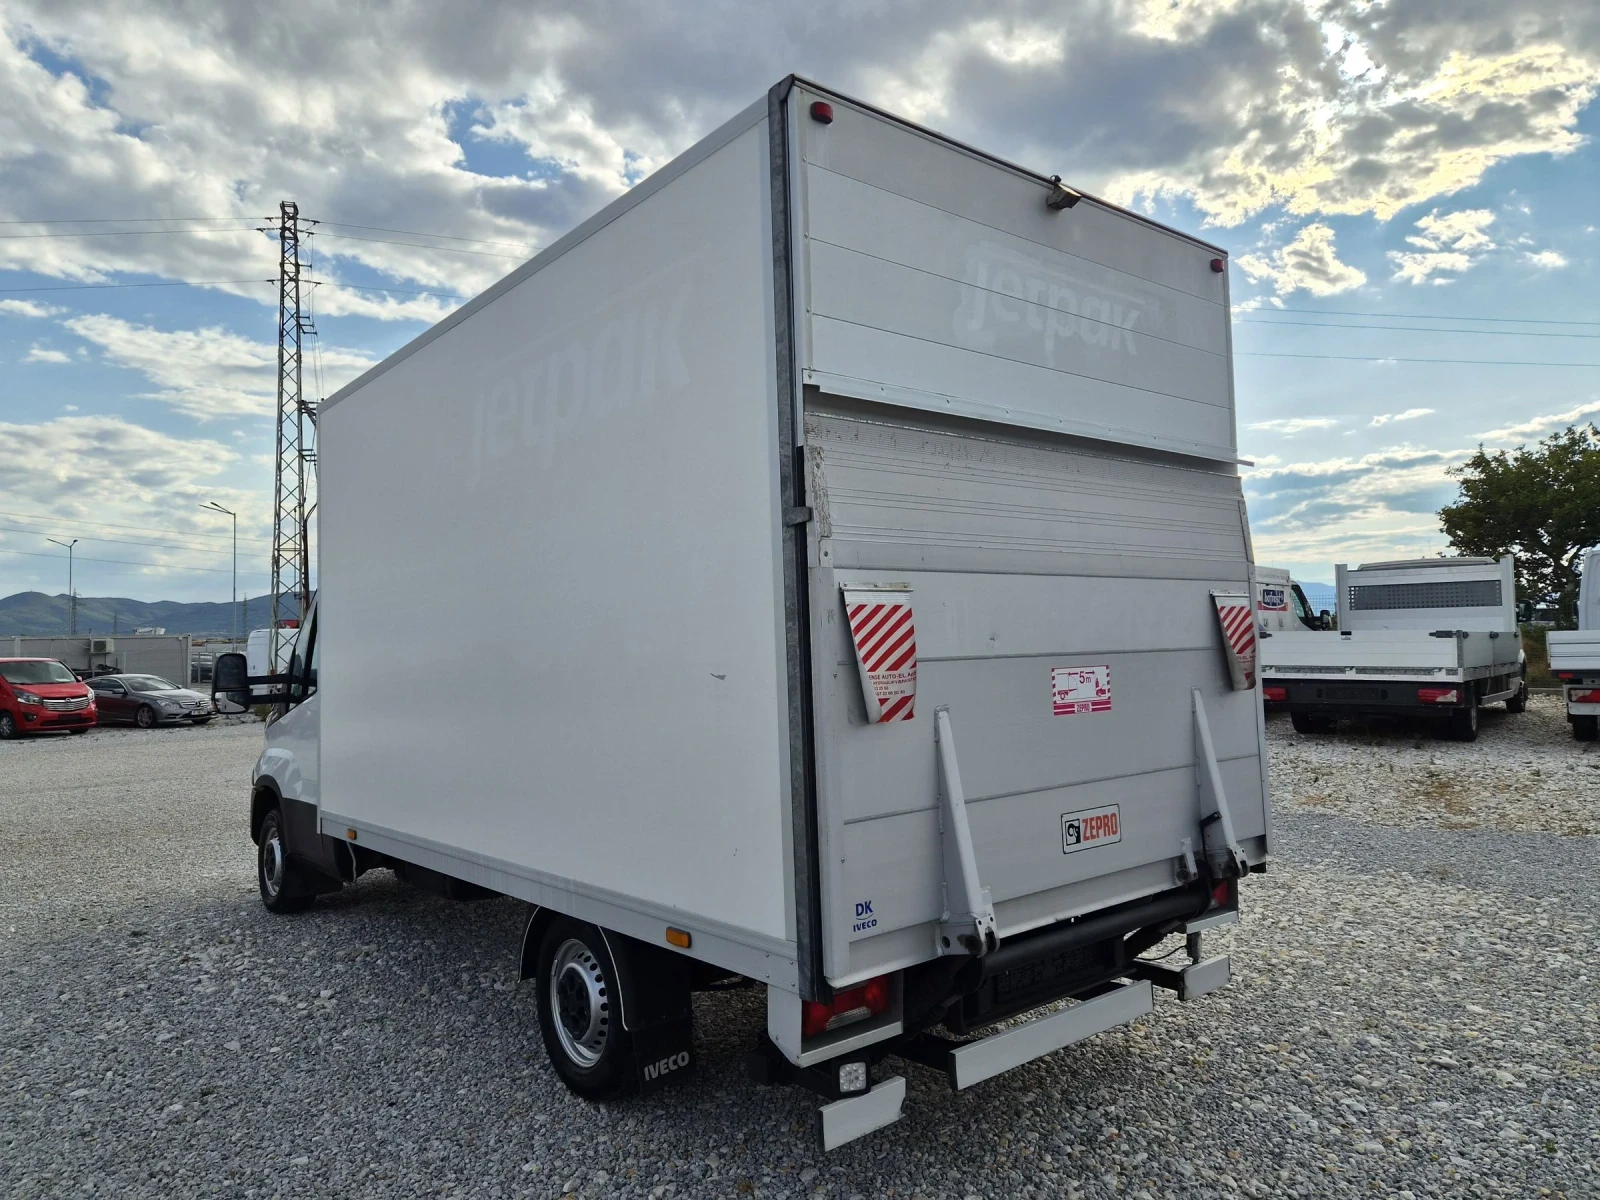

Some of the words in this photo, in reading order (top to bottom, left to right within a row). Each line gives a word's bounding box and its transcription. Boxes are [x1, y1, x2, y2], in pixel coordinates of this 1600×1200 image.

[1082, 812, 1118, 841] ZEPRO
[855, 900, 874, 917] DK
[853, 919, 877, 932] IVECO
[644, 1051, 690, 1081] IVECO
